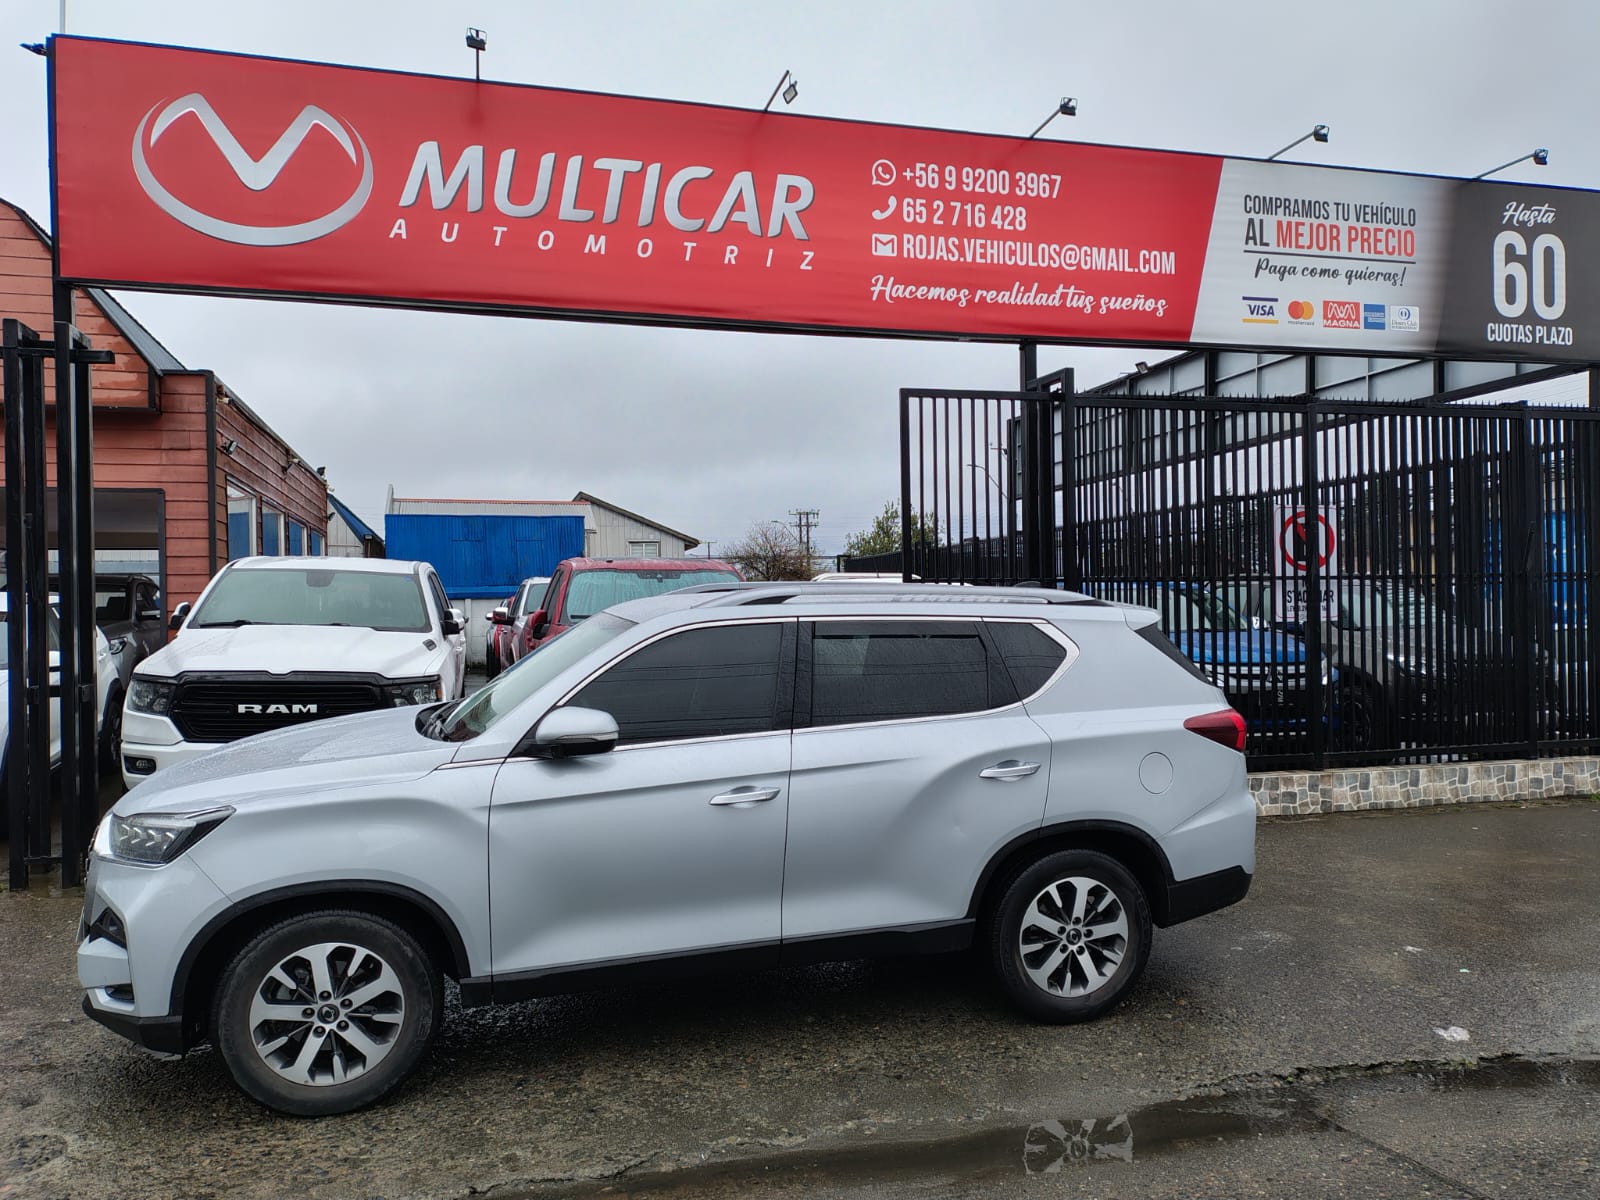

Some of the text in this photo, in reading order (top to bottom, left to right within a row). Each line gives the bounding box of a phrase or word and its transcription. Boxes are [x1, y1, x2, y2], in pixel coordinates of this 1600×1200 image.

[399, 140, 816, 241] MULTICAR
[902, 162, 1062, 199] +56 9 9200 3967
[902, 197, 1026, 231] 65 2 716 428
[1243, 194, 1416, 227] COMPRAMOS TU VEHÍCULO
[1502, 201, 1557, 227] Hasta
[389, 217, 815, 271] AUTOMOTRIZ
[902, 233, 1176, 275] ROJAS.VEHICULOS@GMAIL.COM
[1244, 218, 1415, 257] AL MEJOR PRECIO
[1254, 258, 1407, 287] Paga como quieras!
[1493, 230, 1566, 320] 60
[870, 274, 1168, 317] Hacemos realidad tus sueños
[1247, 304, 1275, 317] VISA
[1322, 319, 1361, 329] MAGNA
[1487, 323, 1573, 346] CUOTAS PLAZO
[237, 704, 318, 714] RAM
